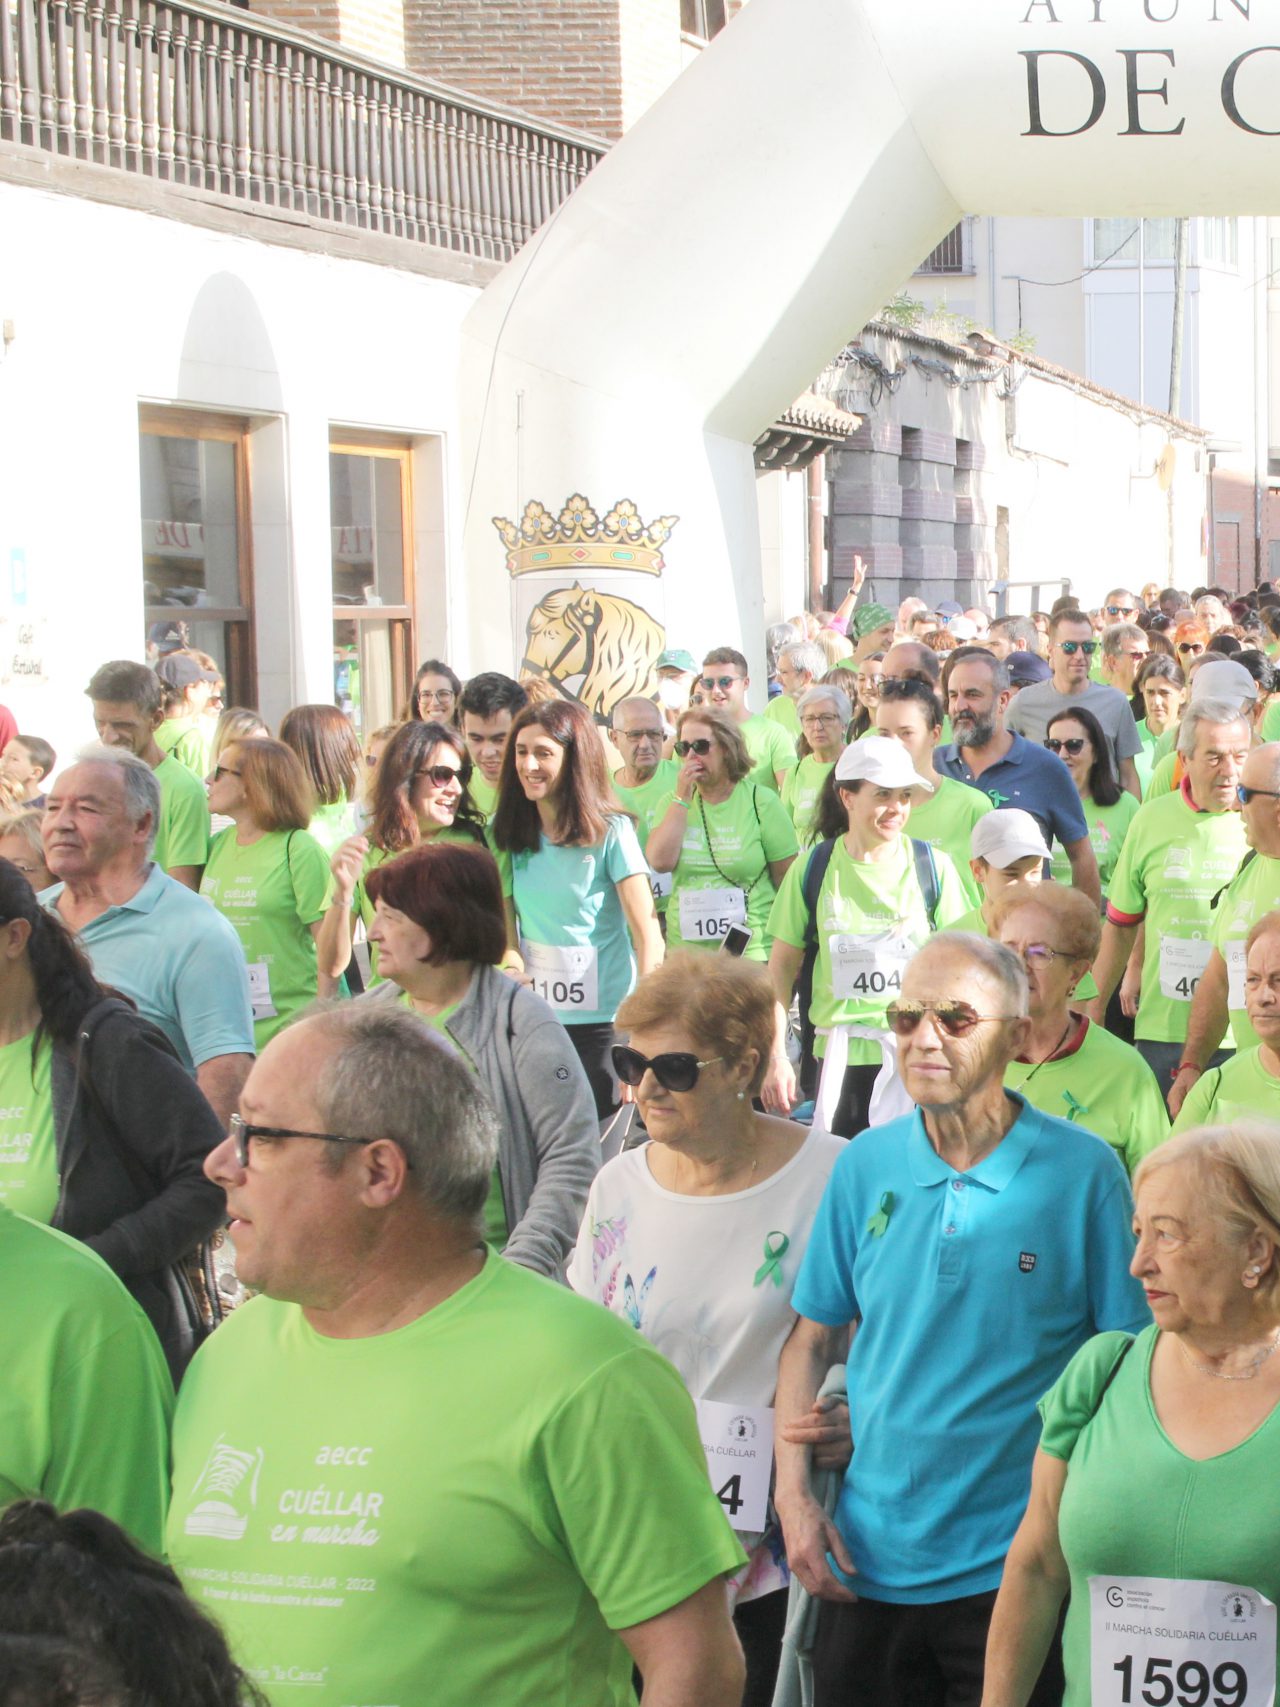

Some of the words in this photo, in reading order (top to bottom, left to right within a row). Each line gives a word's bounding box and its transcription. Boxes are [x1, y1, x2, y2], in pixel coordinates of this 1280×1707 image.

[1018, 48, 1186, 138] DE
[695, 918, 731, 936] 105
[530, 977, 585, 1003] 1105
[853, 969, 902, 993] 404
[315, 1445, 373, 1467] aecc
[717, 1446, 757, 1458] CUÉLLAR
[279, 1483, 384, 1518] CUÉLLAR
[716, 1474, 744, 1516] 4
[270, 1524, 297, 1543] en
[302, 1518, 380, 1546] marcha
[232, 1571, 283, 1587] SOLIDARIA
[287, 1573, 336, 1590] CUÉLLAR
[346, 1577, 376, 1592] 2022
[1113, 1623, 1151, 1635] MARCHA
[1155, 1627, 1205, 1640] SOLIDARIA
[1209, 1630, 1257, 1642] CUÉLLAR
[1113, 1655, 1248, 1707] 1599
